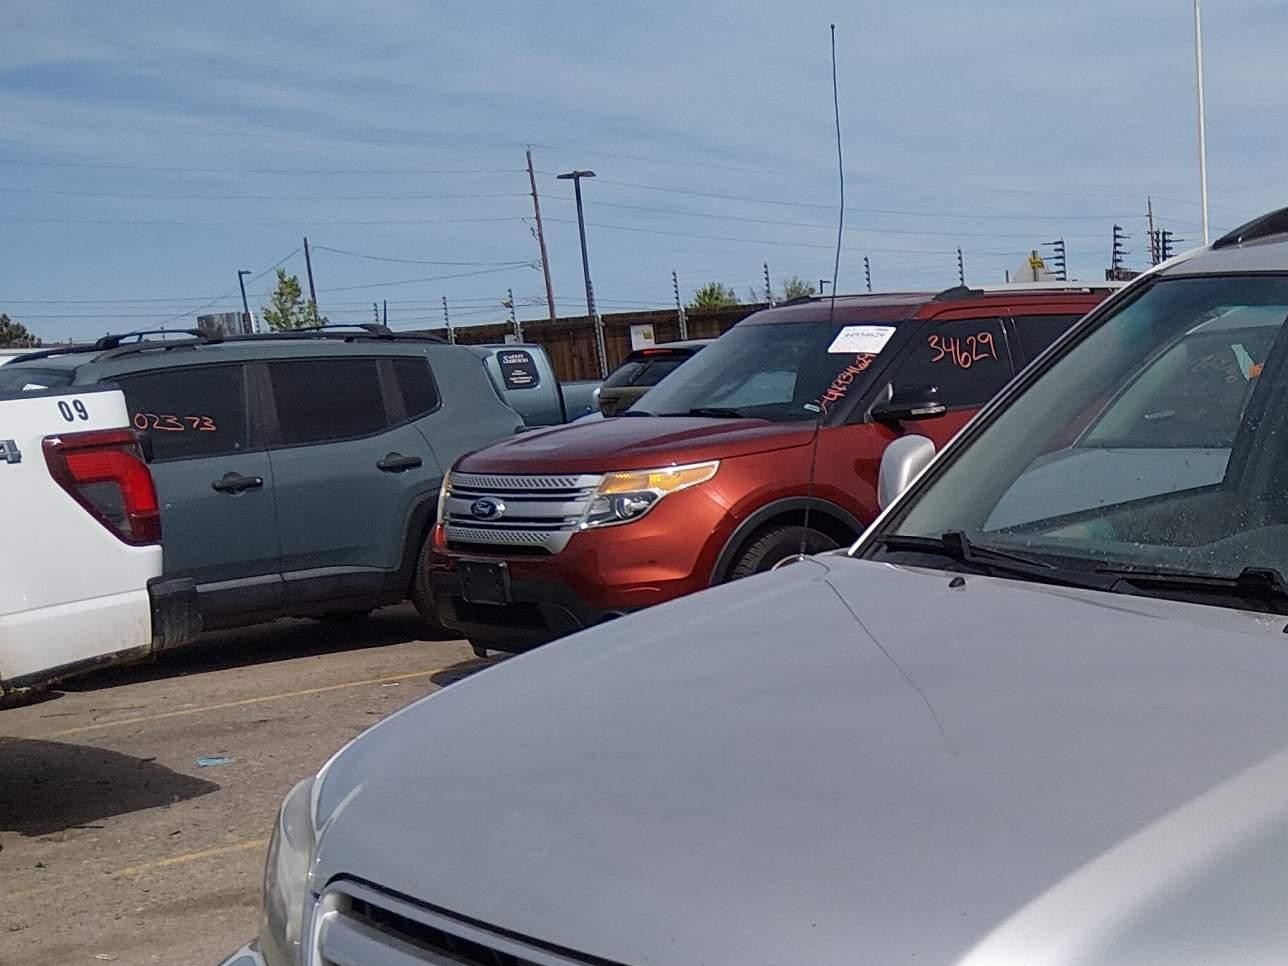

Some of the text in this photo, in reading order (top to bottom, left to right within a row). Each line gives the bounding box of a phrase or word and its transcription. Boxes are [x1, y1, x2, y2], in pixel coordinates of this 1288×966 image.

[928, 332, 998, 368] 34629
[57, 399, 89, 422] 09
[134, 412, 217, 431] 02373
